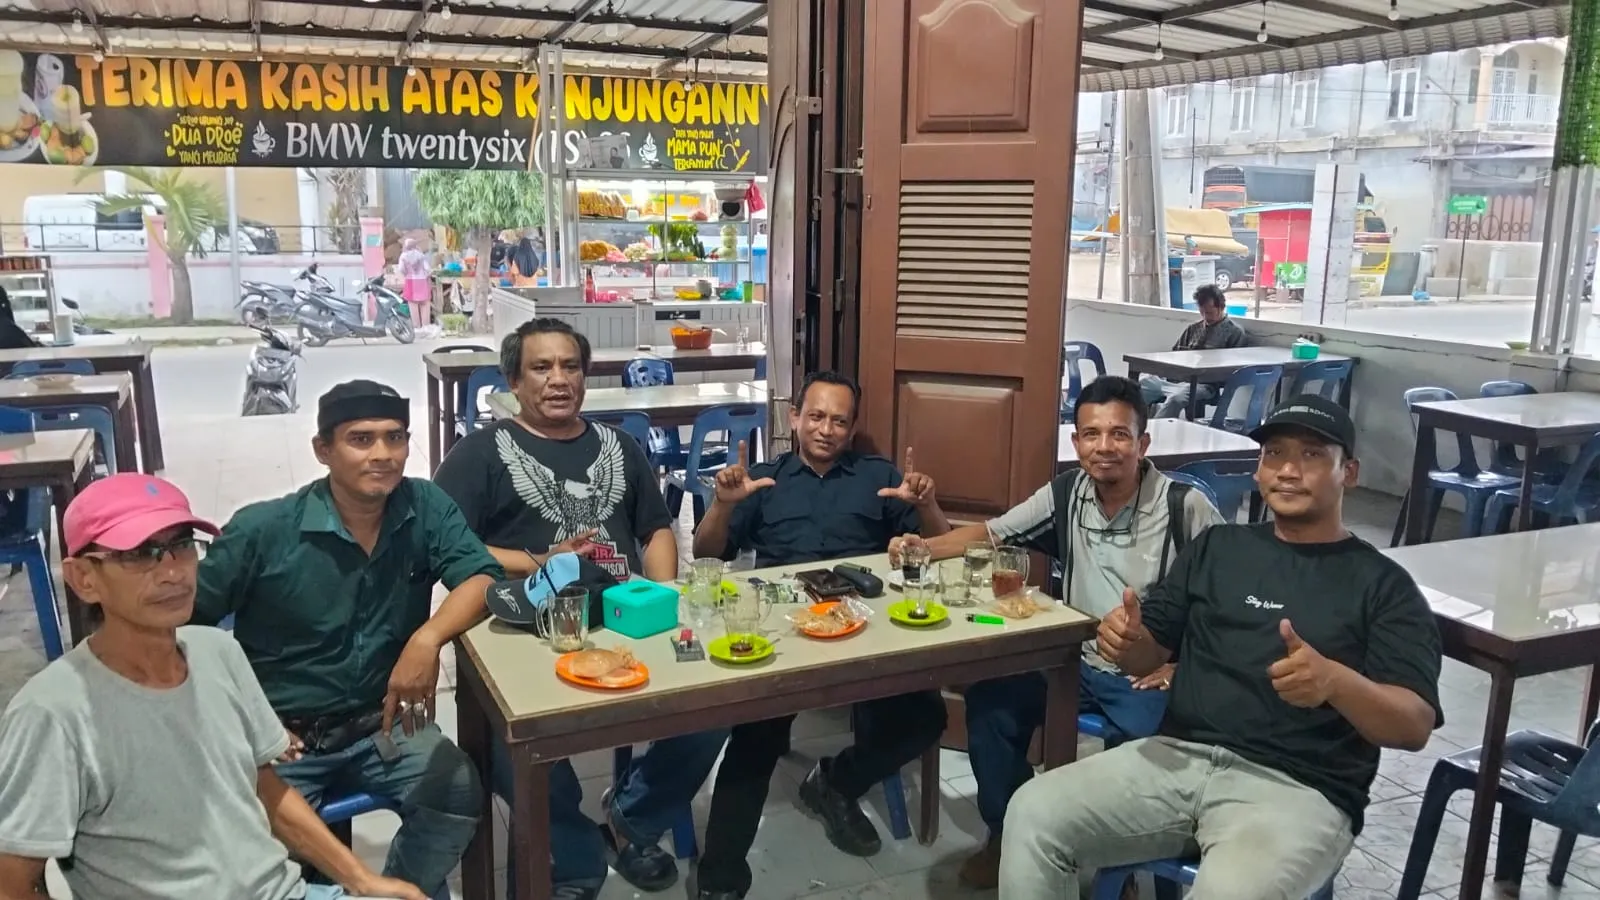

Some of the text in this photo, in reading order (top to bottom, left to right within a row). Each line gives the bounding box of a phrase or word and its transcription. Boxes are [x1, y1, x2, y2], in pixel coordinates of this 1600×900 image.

[76, 55, 768, 126] TERIMA KASIH ATAS KNJUNGANN
[172, 123, 202, 146] DUA
[179, 149, 238, 165] YANG MEURASA
[285, 122, 373, 160] BMW
[381, 126, 528, 171] twentysix
[667, 137, 720, 157] MAMA PUN
